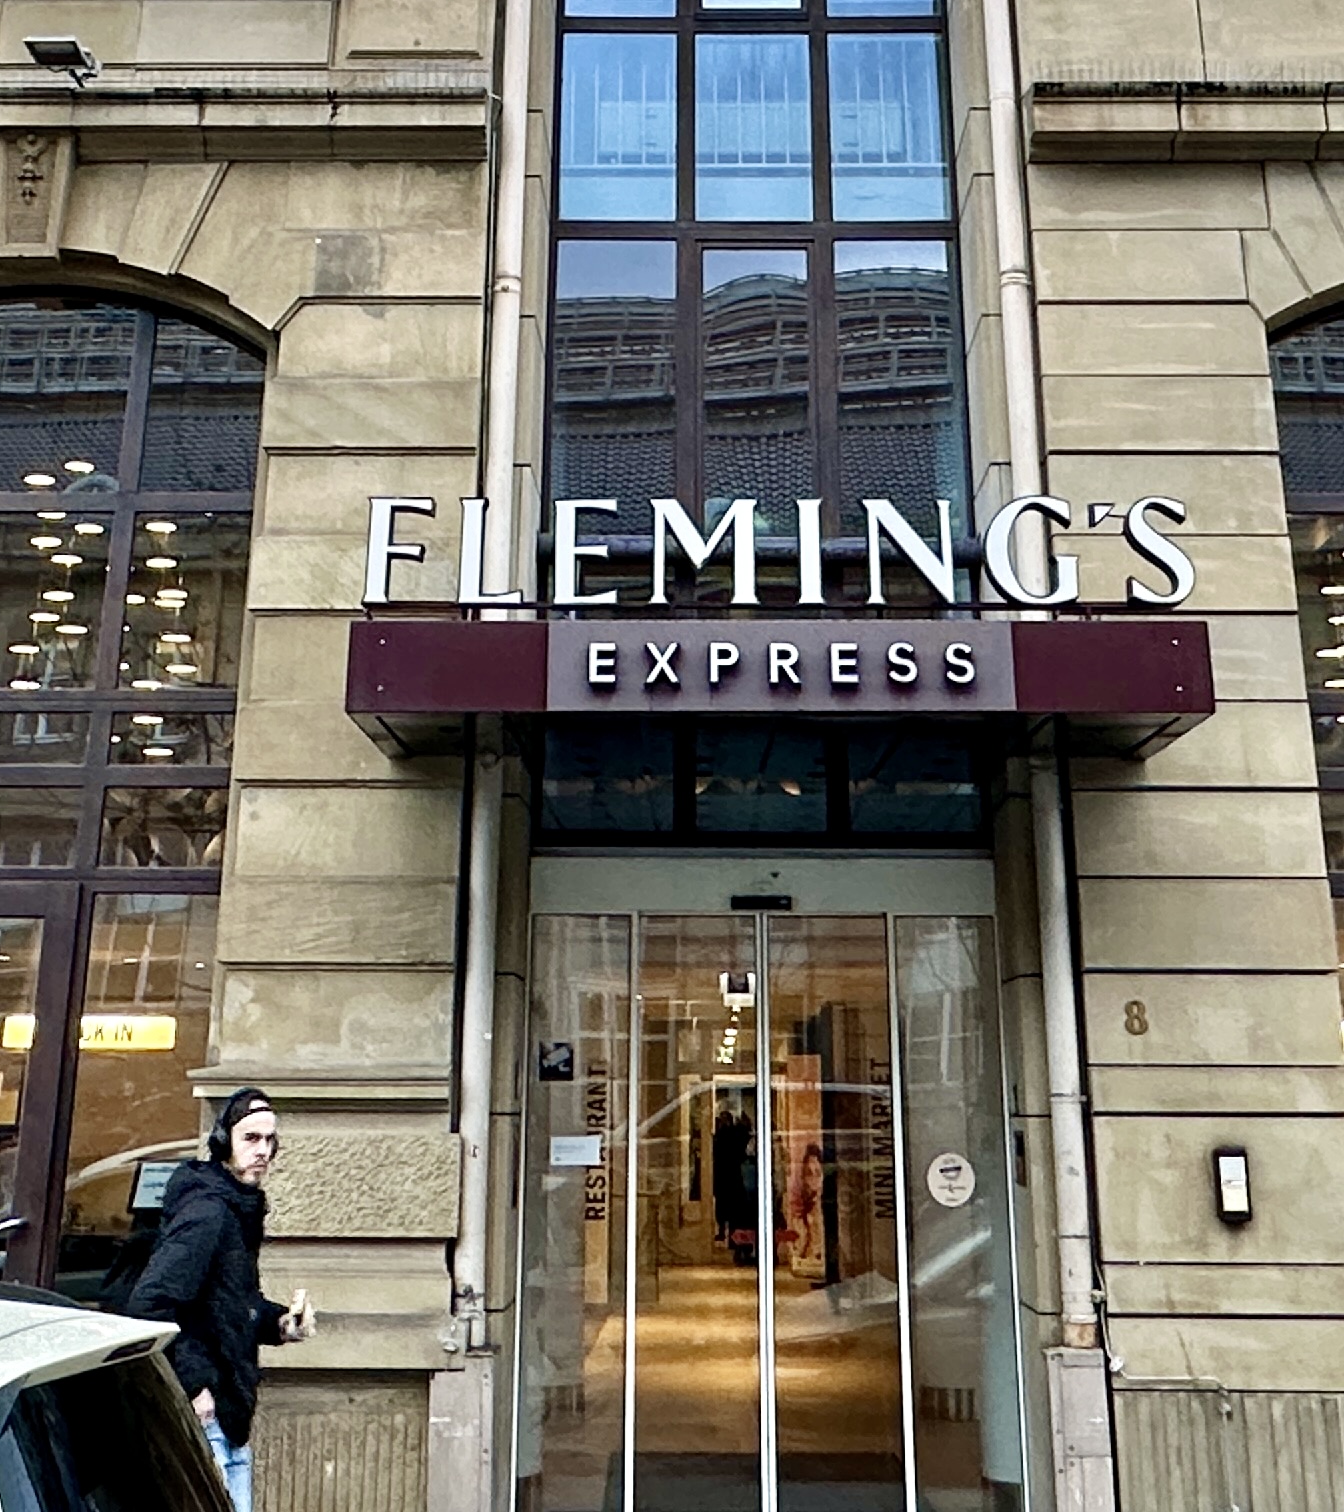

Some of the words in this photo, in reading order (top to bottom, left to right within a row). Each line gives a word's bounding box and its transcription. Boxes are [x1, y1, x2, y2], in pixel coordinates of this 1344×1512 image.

[362, 494, 1197, 607] FLEMING'S
[587, 642, 977, 684] EXPRESS
[1124, 1000, 1149, 1036] 8
[585, 1064, 607, 1221] RESTRANT
[872, 1166, 895, 1220] MINI
